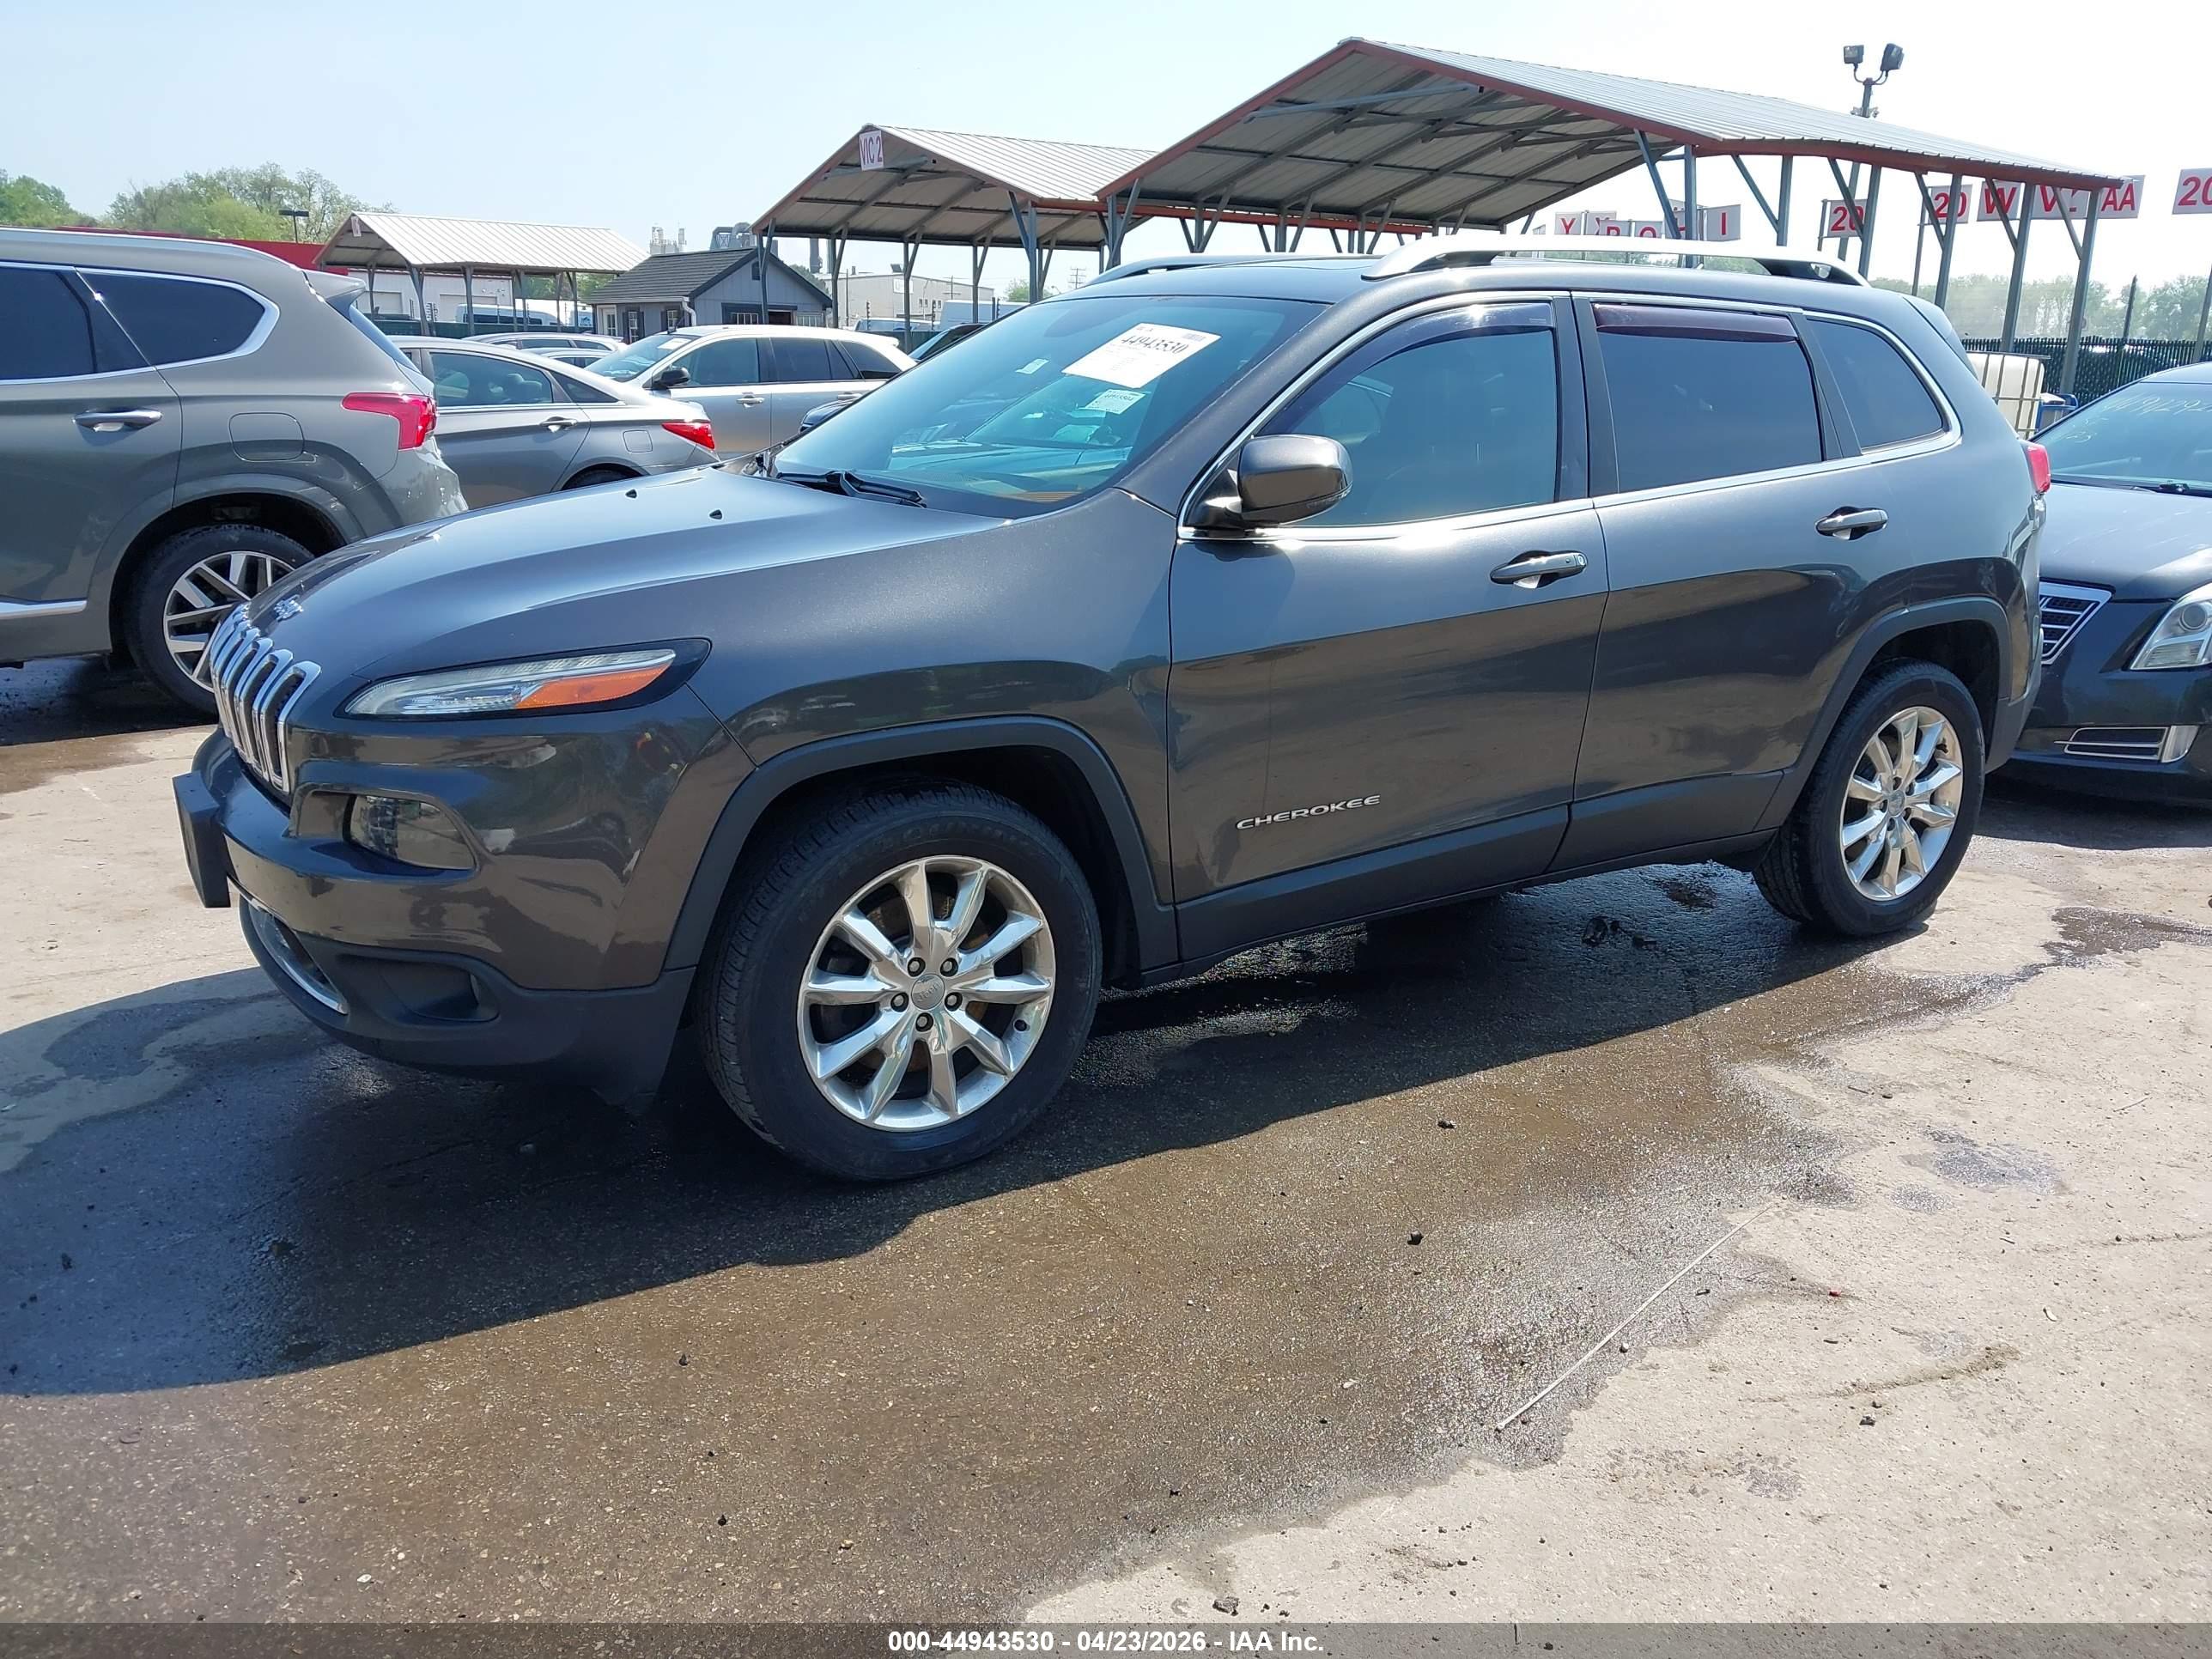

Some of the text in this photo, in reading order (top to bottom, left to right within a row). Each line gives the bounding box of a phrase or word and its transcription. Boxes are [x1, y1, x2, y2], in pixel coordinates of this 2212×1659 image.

[1933, 192, 1967, 218] 20
[1984, 186, 2017, 214] W
[2100, 183, 2136, 211] AA
[1236, 794, 1381, 830] CHEROKEE
